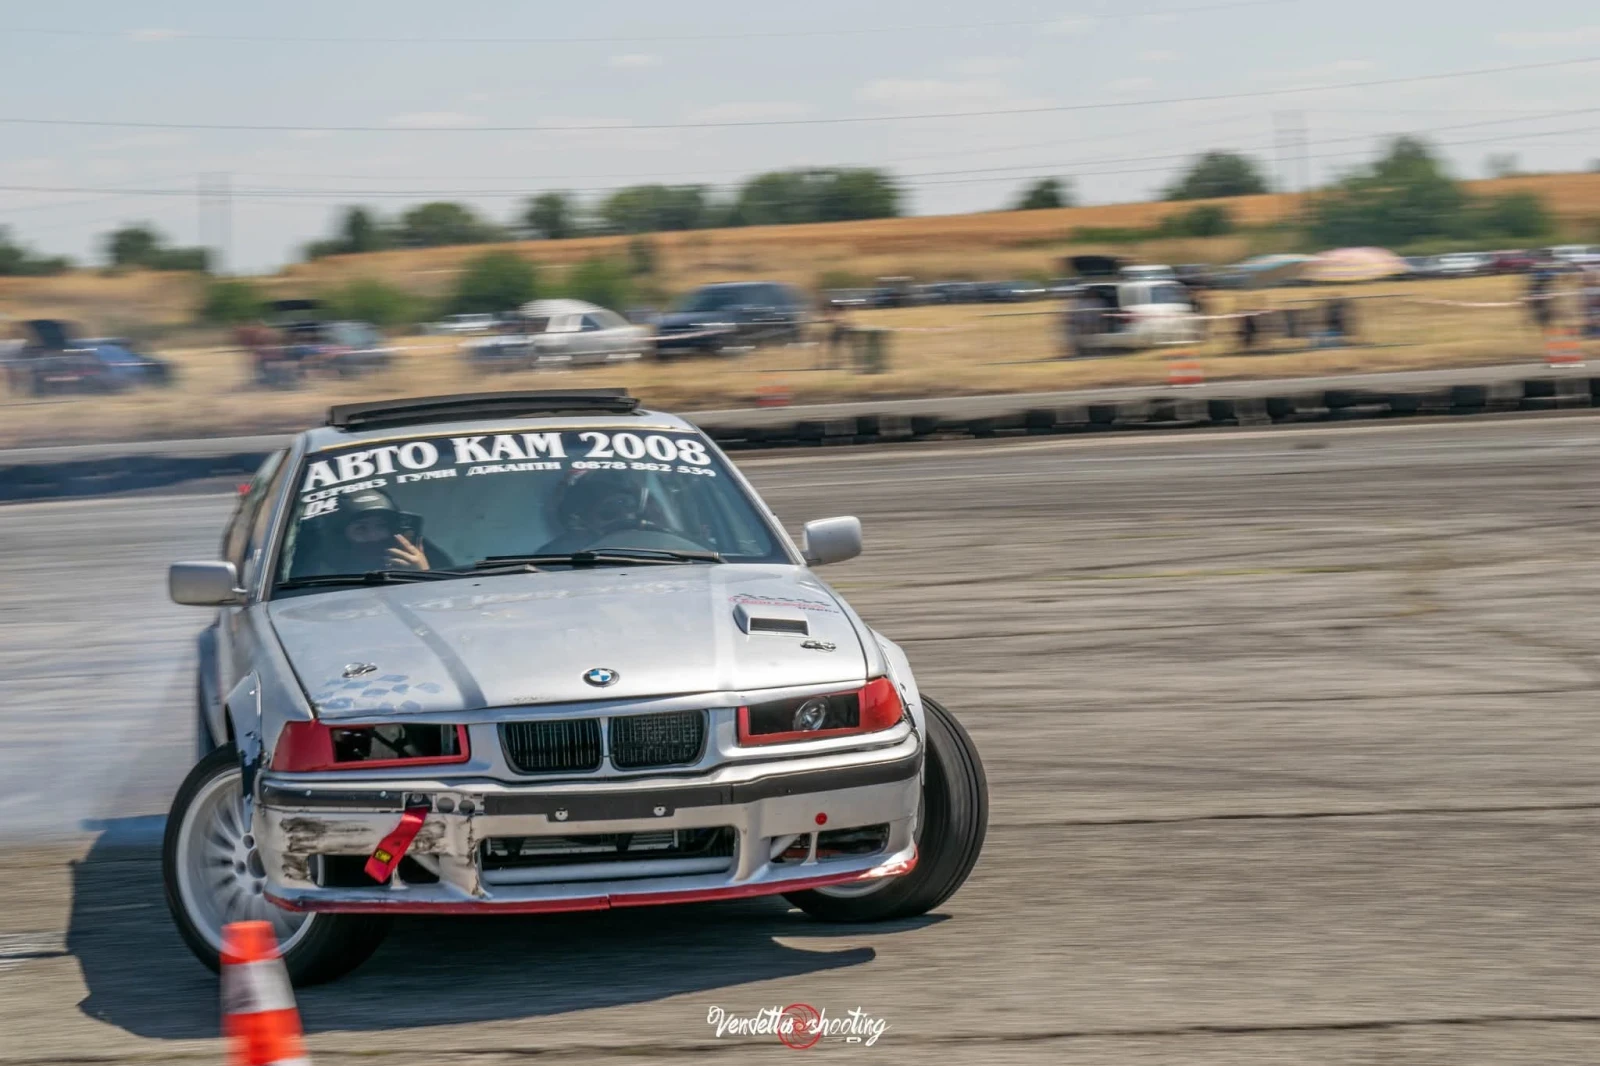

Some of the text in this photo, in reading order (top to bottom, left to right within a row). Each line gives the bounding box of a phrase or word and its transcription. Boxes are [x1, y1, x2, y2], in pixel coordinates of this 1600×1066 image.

[300, 431, 711, 492] АВТО КАМ 2008
[396, 468, 457, 484] ГУМИ
[465, 462, 562, 476] ДЖАНТИ
[570, 461, 627, 470] 0878
